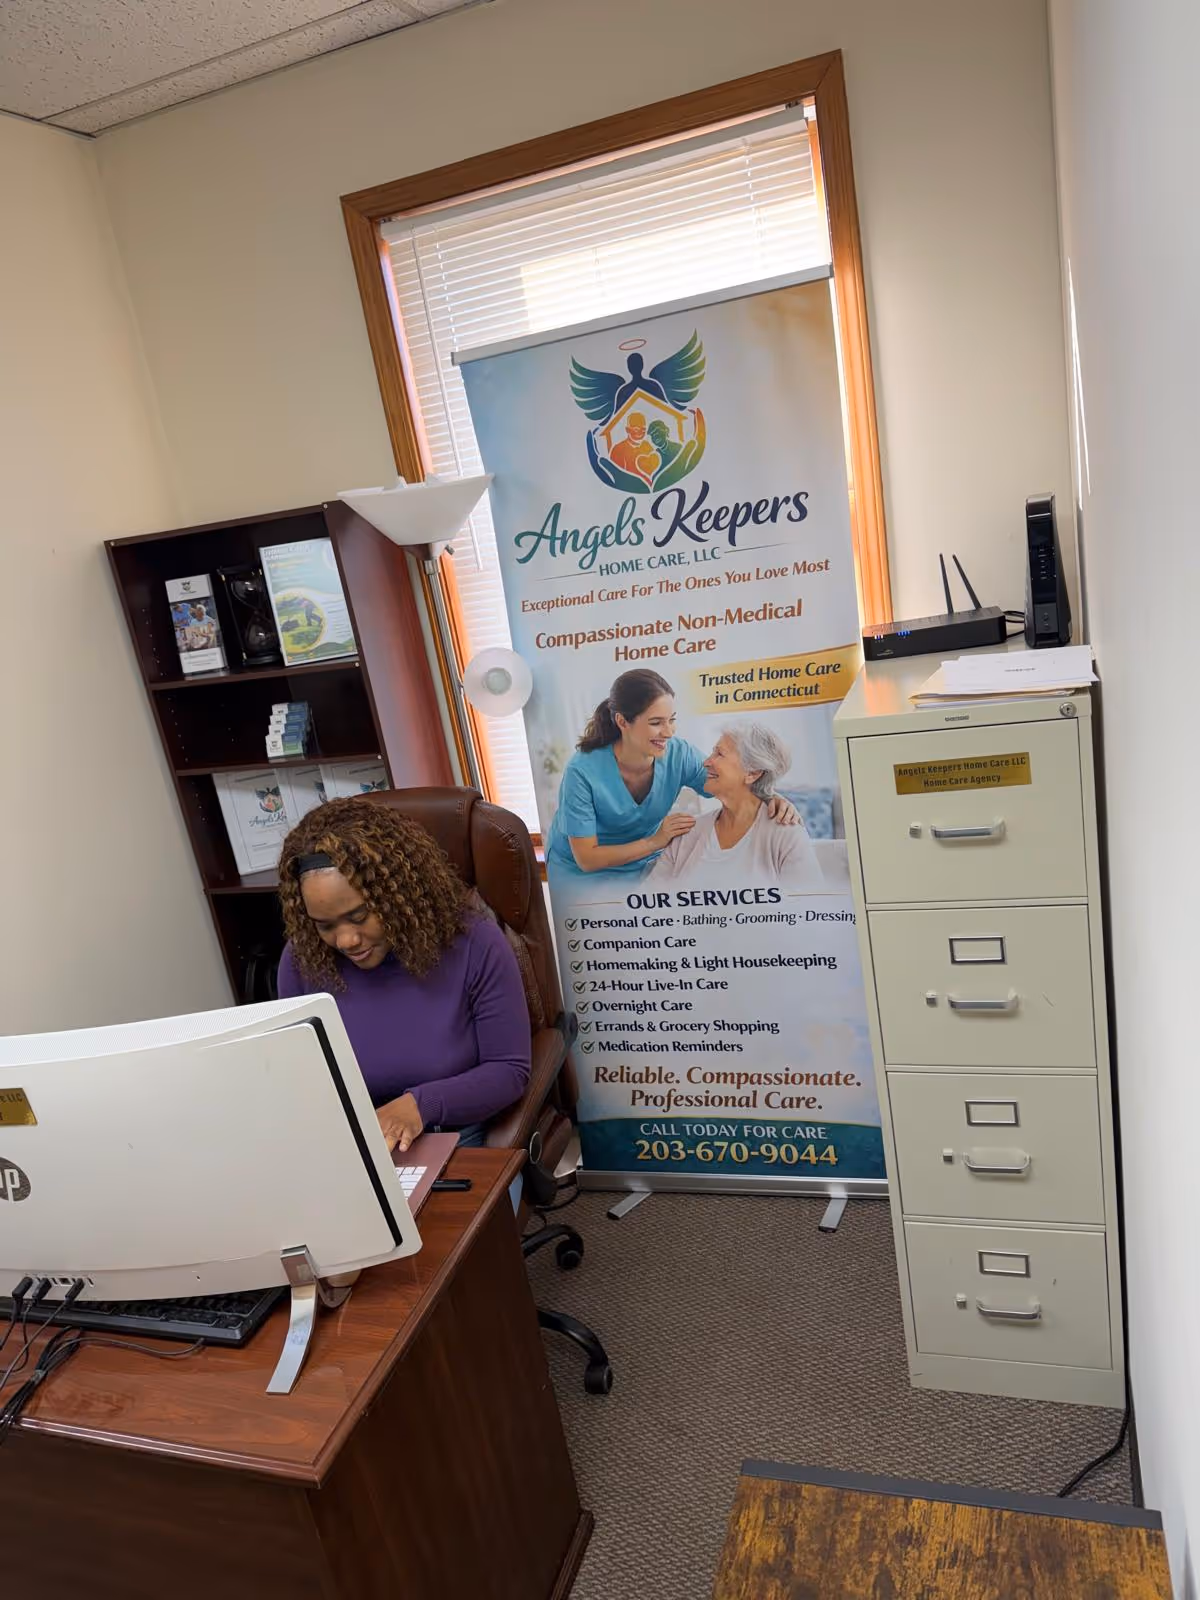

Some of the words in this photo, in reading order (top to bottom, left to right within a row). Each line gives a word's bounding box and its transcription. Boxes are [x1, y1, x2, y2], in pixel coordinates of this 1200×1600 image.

[514, 497, 645, 569] Angels
[651, 480, 809, 547] Keepers
[599, 557, 643, 576] HOME
[647, 552, 690, 569] CARE,
[694, 546, 721, 562] LLC
[521, 591, 594, 612] Exceptional
[598, 586, 628, 602] Care
[631, 584, 653, 598] For
[657, 580, 681, 594] The
[685, 575, 721, 591] Ones
[725, 570, 751, 585] You
[755, 565, 788, 581] Love
[792, 559, 830, 575] Most
[536, 614, 673, 650] Compassionate
[678, 599, 802, 630] Non-Medical
[615, 641, 669, 661] Home
[673, 636, 716, 655] Care
[700, 669, 755, 687] Trusted
[758, 664, 801, 680] Home
[805, 661, 841, 676] Care
[715, 691, 729, 704] in
[733, 683, 820, 702] Connecticut
[898, 768, 925, 776] Angels
[928, 764, 962, 774] Keepers
[964, 761, 987, 770] Home
[990, 759, 1009, 768] Care
[1012, 757, 1026, 765] LLC
[924, 778, 946, 787] Home
[949, 777, 968, 785] Care
[970, 774, 1001, 784] Agency
[627, 893, 672, 909] OUR
[677, 888, 781, 907] SERVICES
[580, 916, 638, 930] Personal
[642, 915, 674, 928] Care
[683, 914, 727, 928] Bathing
[735, 912, 797, 926] Grooming
[584, 938, 661, 952] Companion
[664, 936, 696, 948] Care
[587, 959, 678, 973] Homemaking
[681, 957, 691, 969] &
[694, 956, 729, 972] Light
[733, 954, 837, 970] Housekeeping
[589, 980, 644, 992] 24-Hour
[647, 979, 693, 991] Live-In
[696, 978, 728, 991] Care
[592, 1000, 657, 1014] Overnight
[661, 1000, 693, 1012] Care
[595, 1021, 644, 1032] Errands
[647, 1021, 656, 1032] &
[659, 1021, 710, 1034] Grocery
[713, 1020, 780, 1034] Shopping
[598, 1041, 669, 1053] Medication
[672, 1041, 743, 1053] Reminders
[594, 1066, 680, 1084] Reliable.
[686, 1066, 861, 1090] Compassionate.
[630, 1089, 758, 1112] Professional
[764, 1092, 822, 1110] Care.
[640, 1123, 680, 1136] CALL
[683, 1124, 739, 1137] TODAY
[744, 1126, 778, 1138] FOR
[781, 1126, 827, 1140] CARE
[633, 1140, 838, 1166] 203-670-9044
[0, 1169, 20, 1203] p
